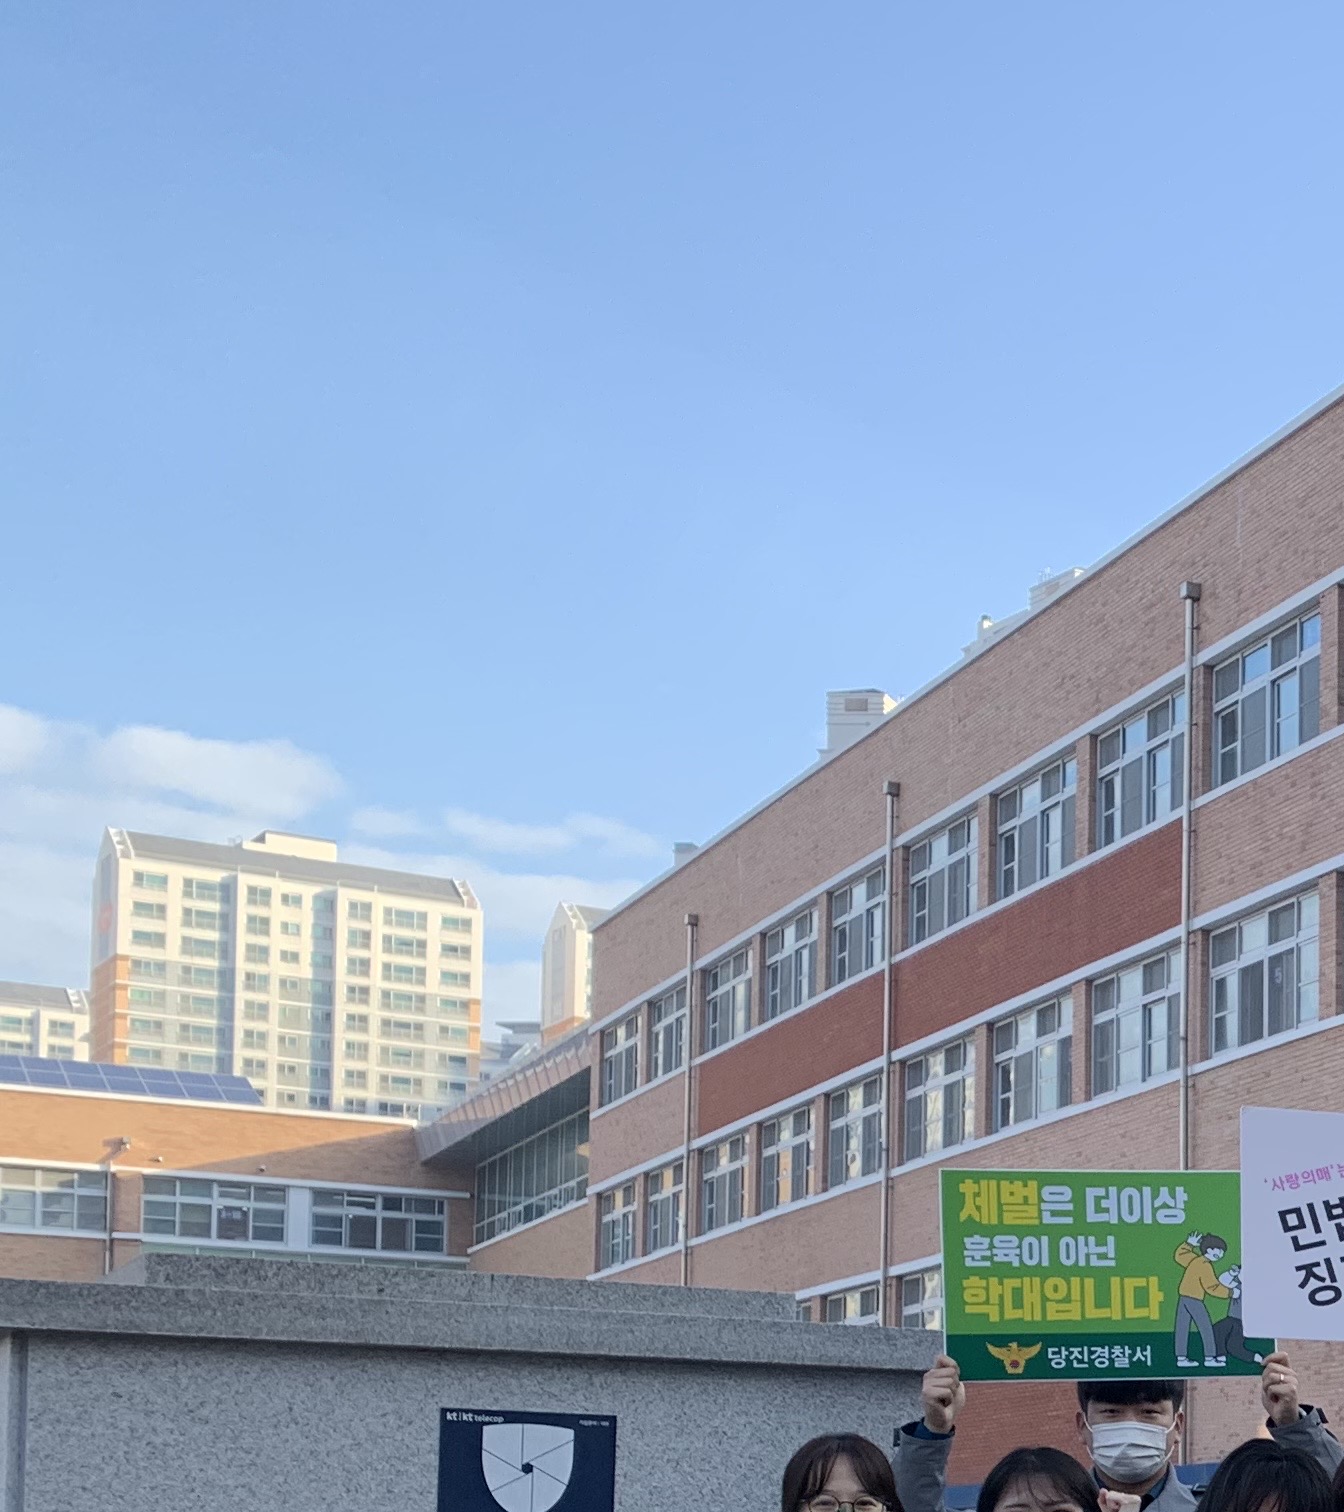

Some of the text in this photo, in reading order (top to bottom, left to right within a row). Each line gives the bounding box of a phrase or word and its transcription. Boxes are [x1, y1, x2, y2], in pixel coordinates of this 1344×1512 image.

[958, 1180, 1187, 1227] 체벌은 더이상
[963, 1235, 1116, 1268] 훈육이 아닌
[962, 1275, 1164, 1323] 학대입니다
[1047, 1343, 1153, 1371] 당진경찰서
